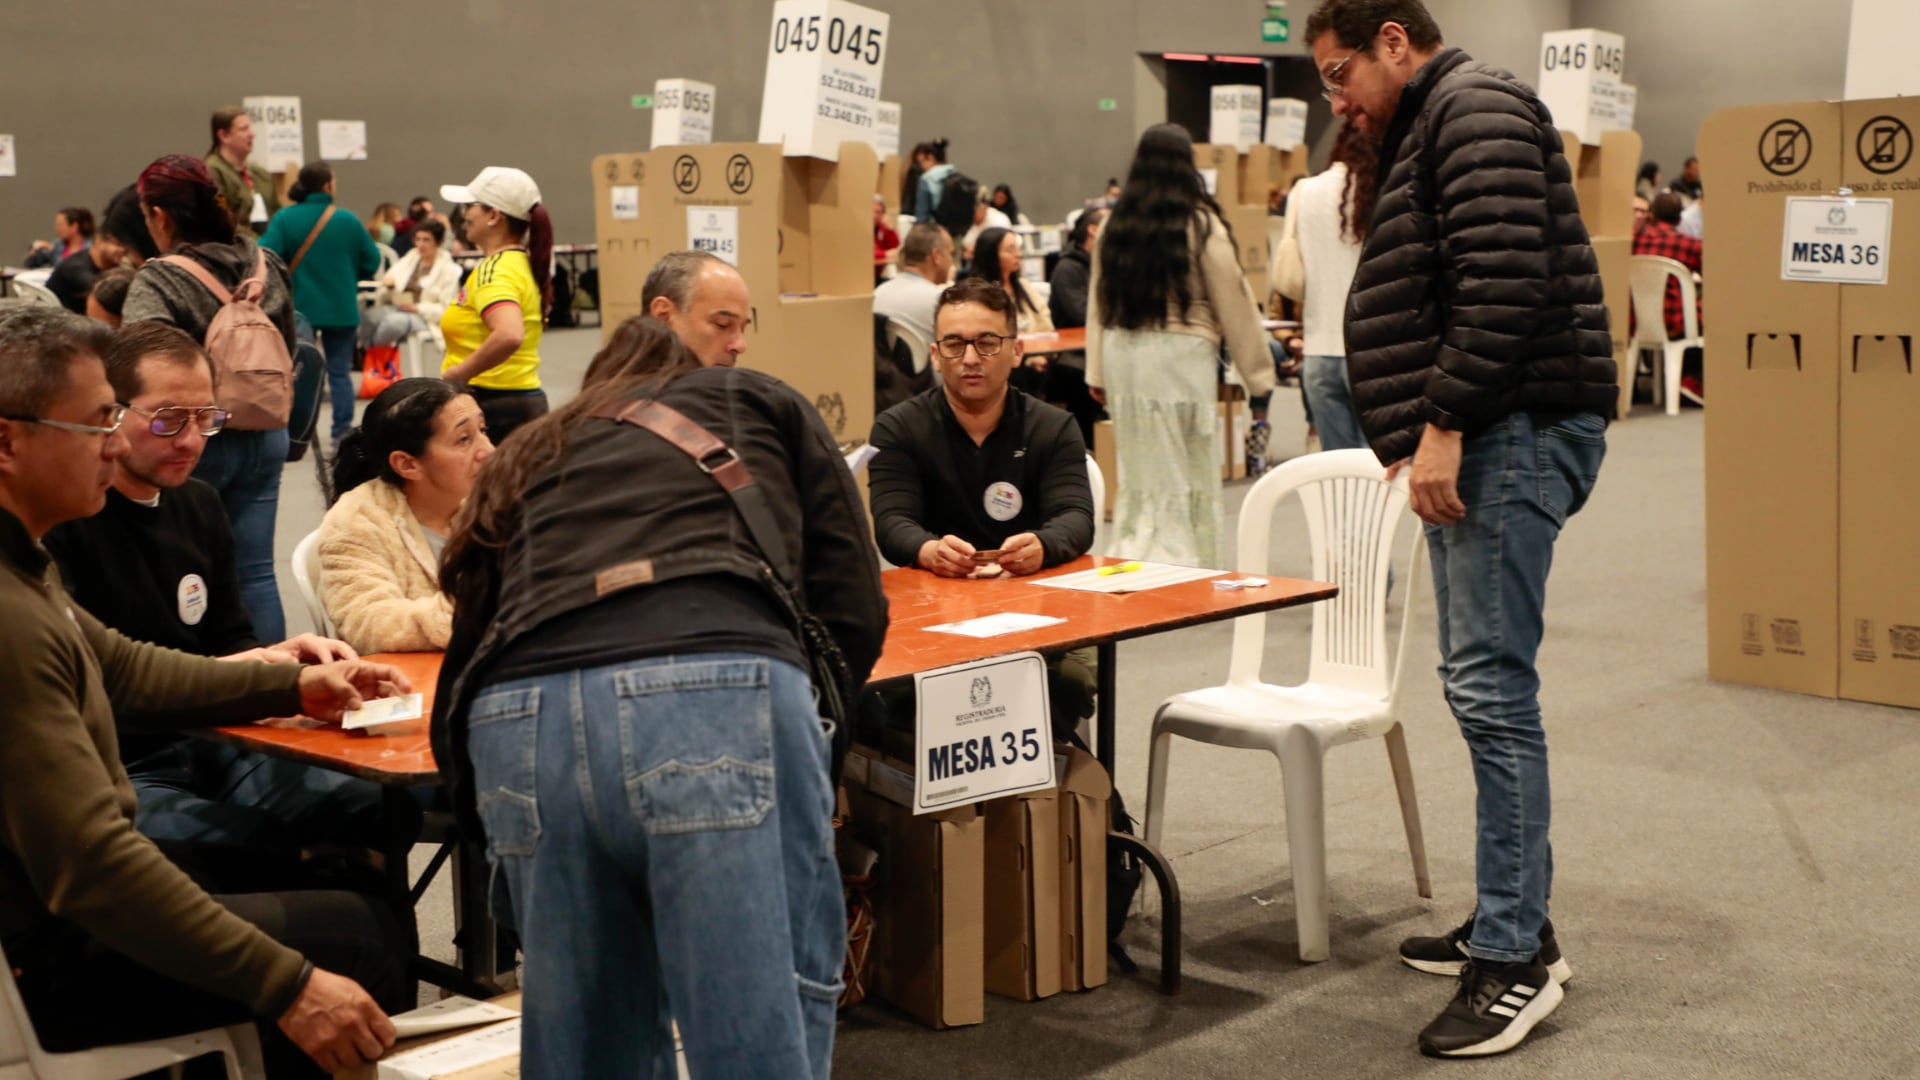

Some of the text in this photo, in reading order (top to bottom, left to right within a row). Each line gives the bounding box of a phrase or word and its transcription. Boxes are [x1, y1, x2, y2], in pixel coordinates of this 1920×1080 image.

[775, 16, 820, 53] 045
[828, 17, 882, 65] 045
[1545, 43, 1586, 71] 046
[1594, 44, 1622, 75] 046
[656, 89, 679, 109] 055
[683, 90, 710, 113] 055
[267, 106, 297, 124] 064
[1747, 180, 1807, 193] Prohibido
[1809, 178, 1822, 192] el
[1871, 178, 1888, 191] de
[693, 238, 734, 254] MESA 45
[1791, 242, 1879, 265] MESA 36
[928, 728, 1040, 782] MESA 35
